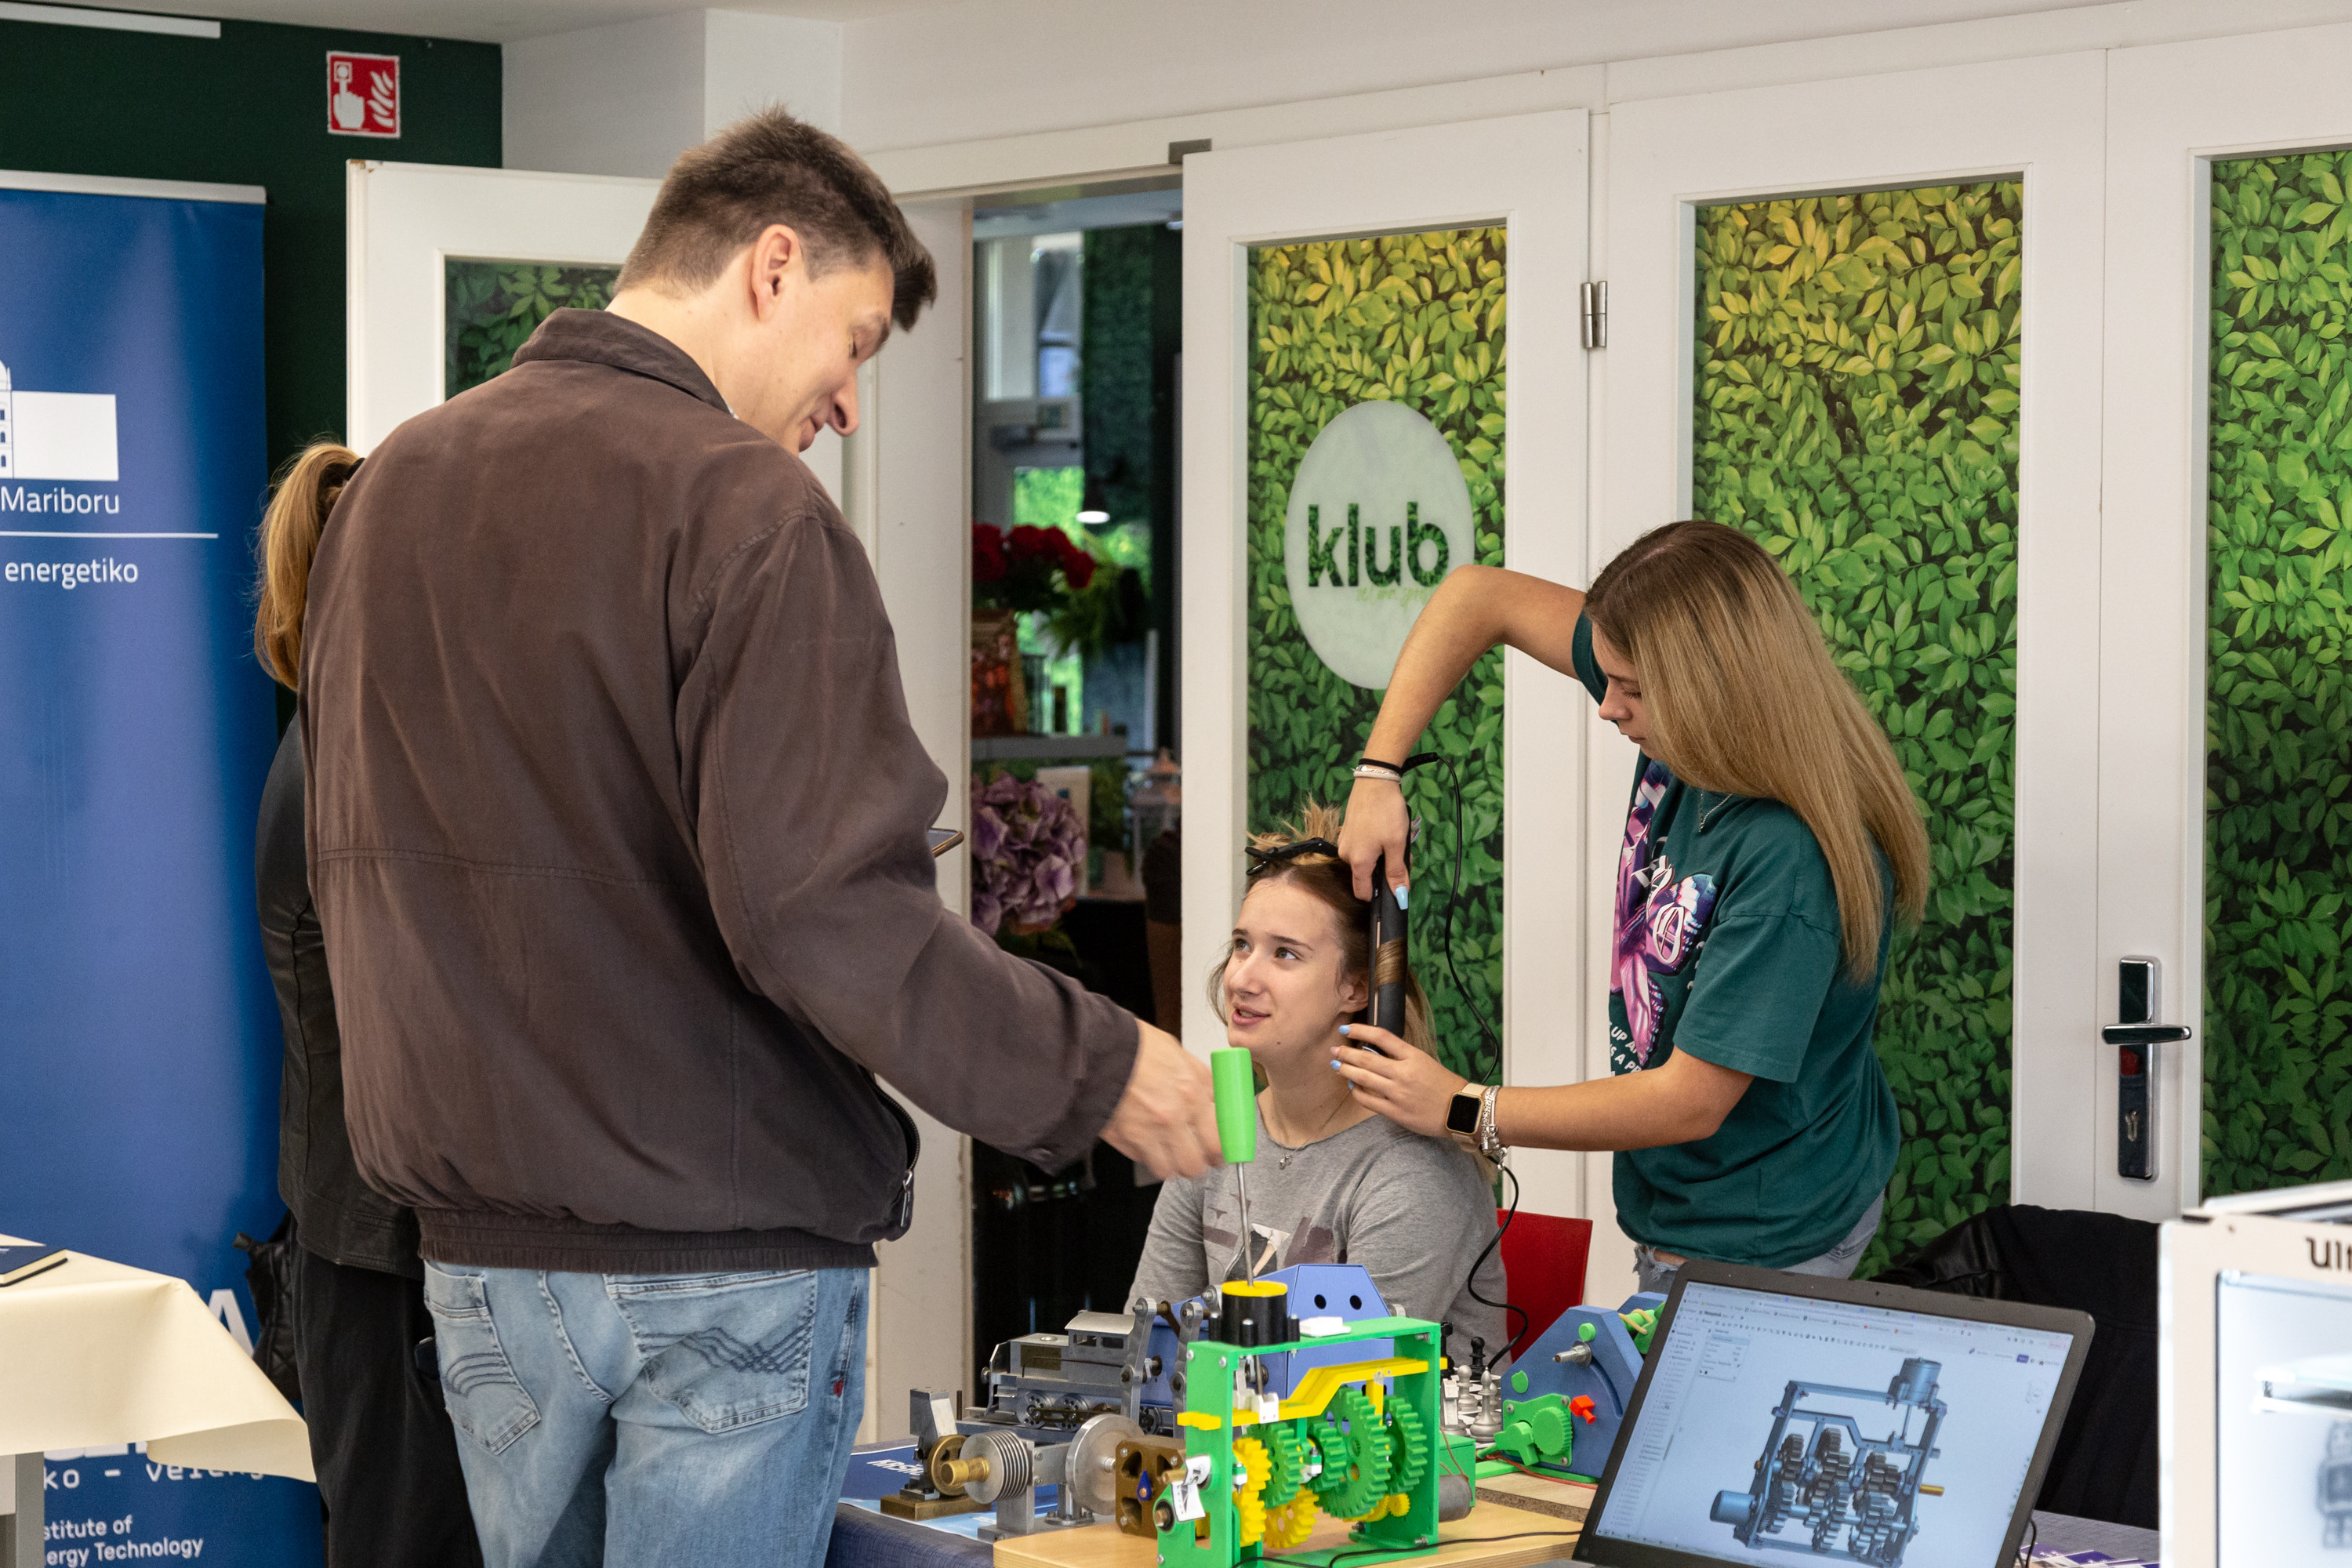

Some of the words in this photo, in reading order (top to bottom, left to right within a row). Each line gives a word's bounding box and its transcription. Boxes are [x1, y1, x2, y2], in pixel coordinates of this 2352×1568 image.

[1, 486, 120, 514] Mariboru
[1308, 501, 1449, 587] klub
[5, 557, 140, 590] energetiko
[1611, 1026, 1628, 1040] UP
[1624, 1040, 1637, 1054] A
[1614, 1054, 1626, 1065] A
[112, 1514, 133, 1534] of
[94, 1536, 204, 1561] Technology
